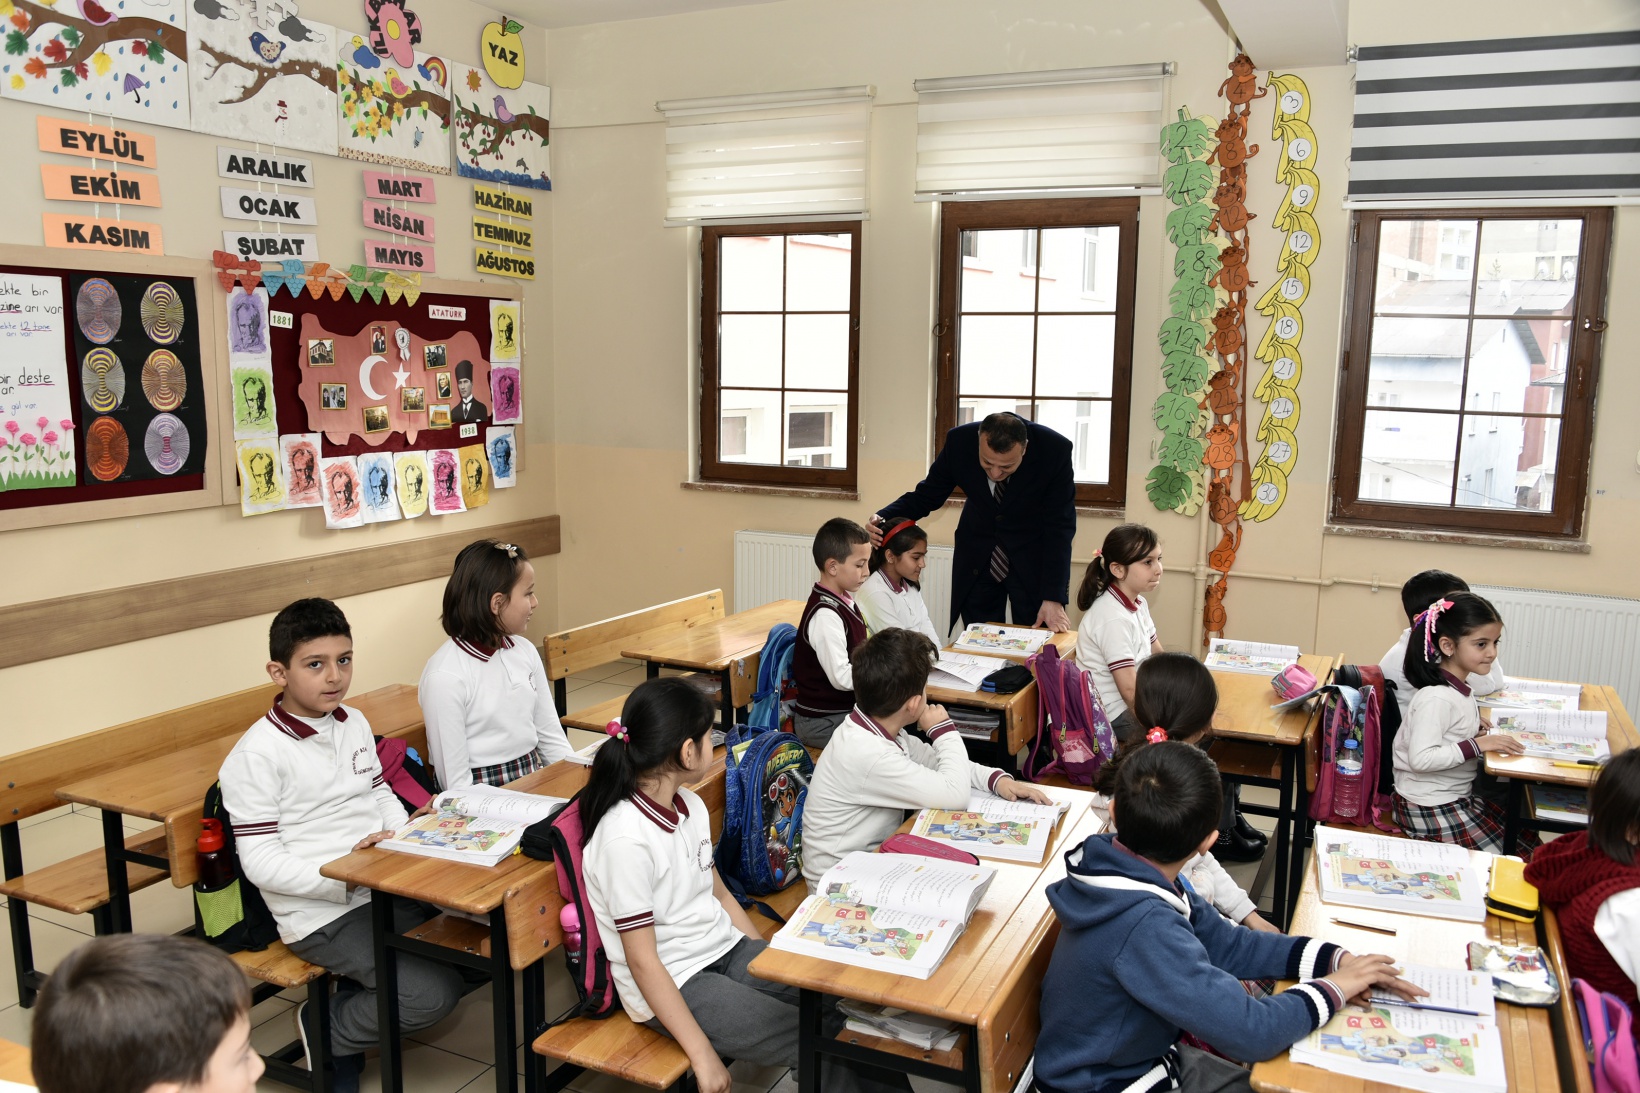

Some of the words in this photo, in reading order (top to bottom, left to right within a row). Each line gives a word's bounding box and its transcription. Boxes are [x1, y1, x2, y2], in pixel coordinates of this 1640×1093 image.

[488, 42, 519, 66] YAZ
[1232, 81, 1247, 99] 4
[1283, 94, 1300, 109] 3
[60, 128, 144, 162] EYLÜL
[1173, 124, 1193, 149] 2
[1225, 141, 1238, 161] 8
[1295, 142, 1306, 158] 6
[226, 154, 308, 183] ARALIK
[70, 171, 141, 200] EKİM
[377, 179, 422, 198] MART
[1178, 168, 1197, 197] 4
[239, 195, 301, 219] OCAK
[474, 191, 533, 216] HAZİRAN
[1299, 188, 1309, 205] 9
[373, 206, 425, 236] NİSAN
[1181, 210, 1197, 237] 6
[1223, 205, 1245, 227] 12
[64, 222, 150, 249] KASIM
[474, 222, 532, 247] TEMMUZ
[1294, 233, 1309, 249] 12
[237, 236, 305, 262] ŞUBAT
[374, 246, 424, 268] MAYIS
[476, 250, 535, 276] AĞUSTOS
[1192, 249, 1206, 273] 8
[1225, 266, 1244, 286] 16
[31, 283, 49, 296] bir
[1186, 285, 1207, 309] 10
[1284, 279, 1300, 296] 15
[24, 304, 39, 313] arı
[43, 305, 63, 315] var
[431, 307, 463, 319] ATATÜRK
[272, 314, 292, 327] 1881
[1279, 318, 1294, 335] 18
[1174, 325, 1194, 350] 12
[1218, 328, 1238, 349] 20
[18, 366, 53, 385] deste
[1176, 358, 1197, 385] 14
[1274, 360, 1292, 376] 21
[1168, 397, 1188, 421] 16
[1213, 390, 1237, 411] 24
[1272, 400, 1292, 415] 24
[461, 426, 476, 436] 1938
[1172, 439, 1192, 461] 18
[1210, 445, 1235, 465] 28
[1269, 443, 1291, 459] 27
[1156, 471, 1187, 494] 20
[1257, 484, 1279, 502] 30
[1214, 497, 1237, 521] 32
[1213, 553, 1233, 568] 36
